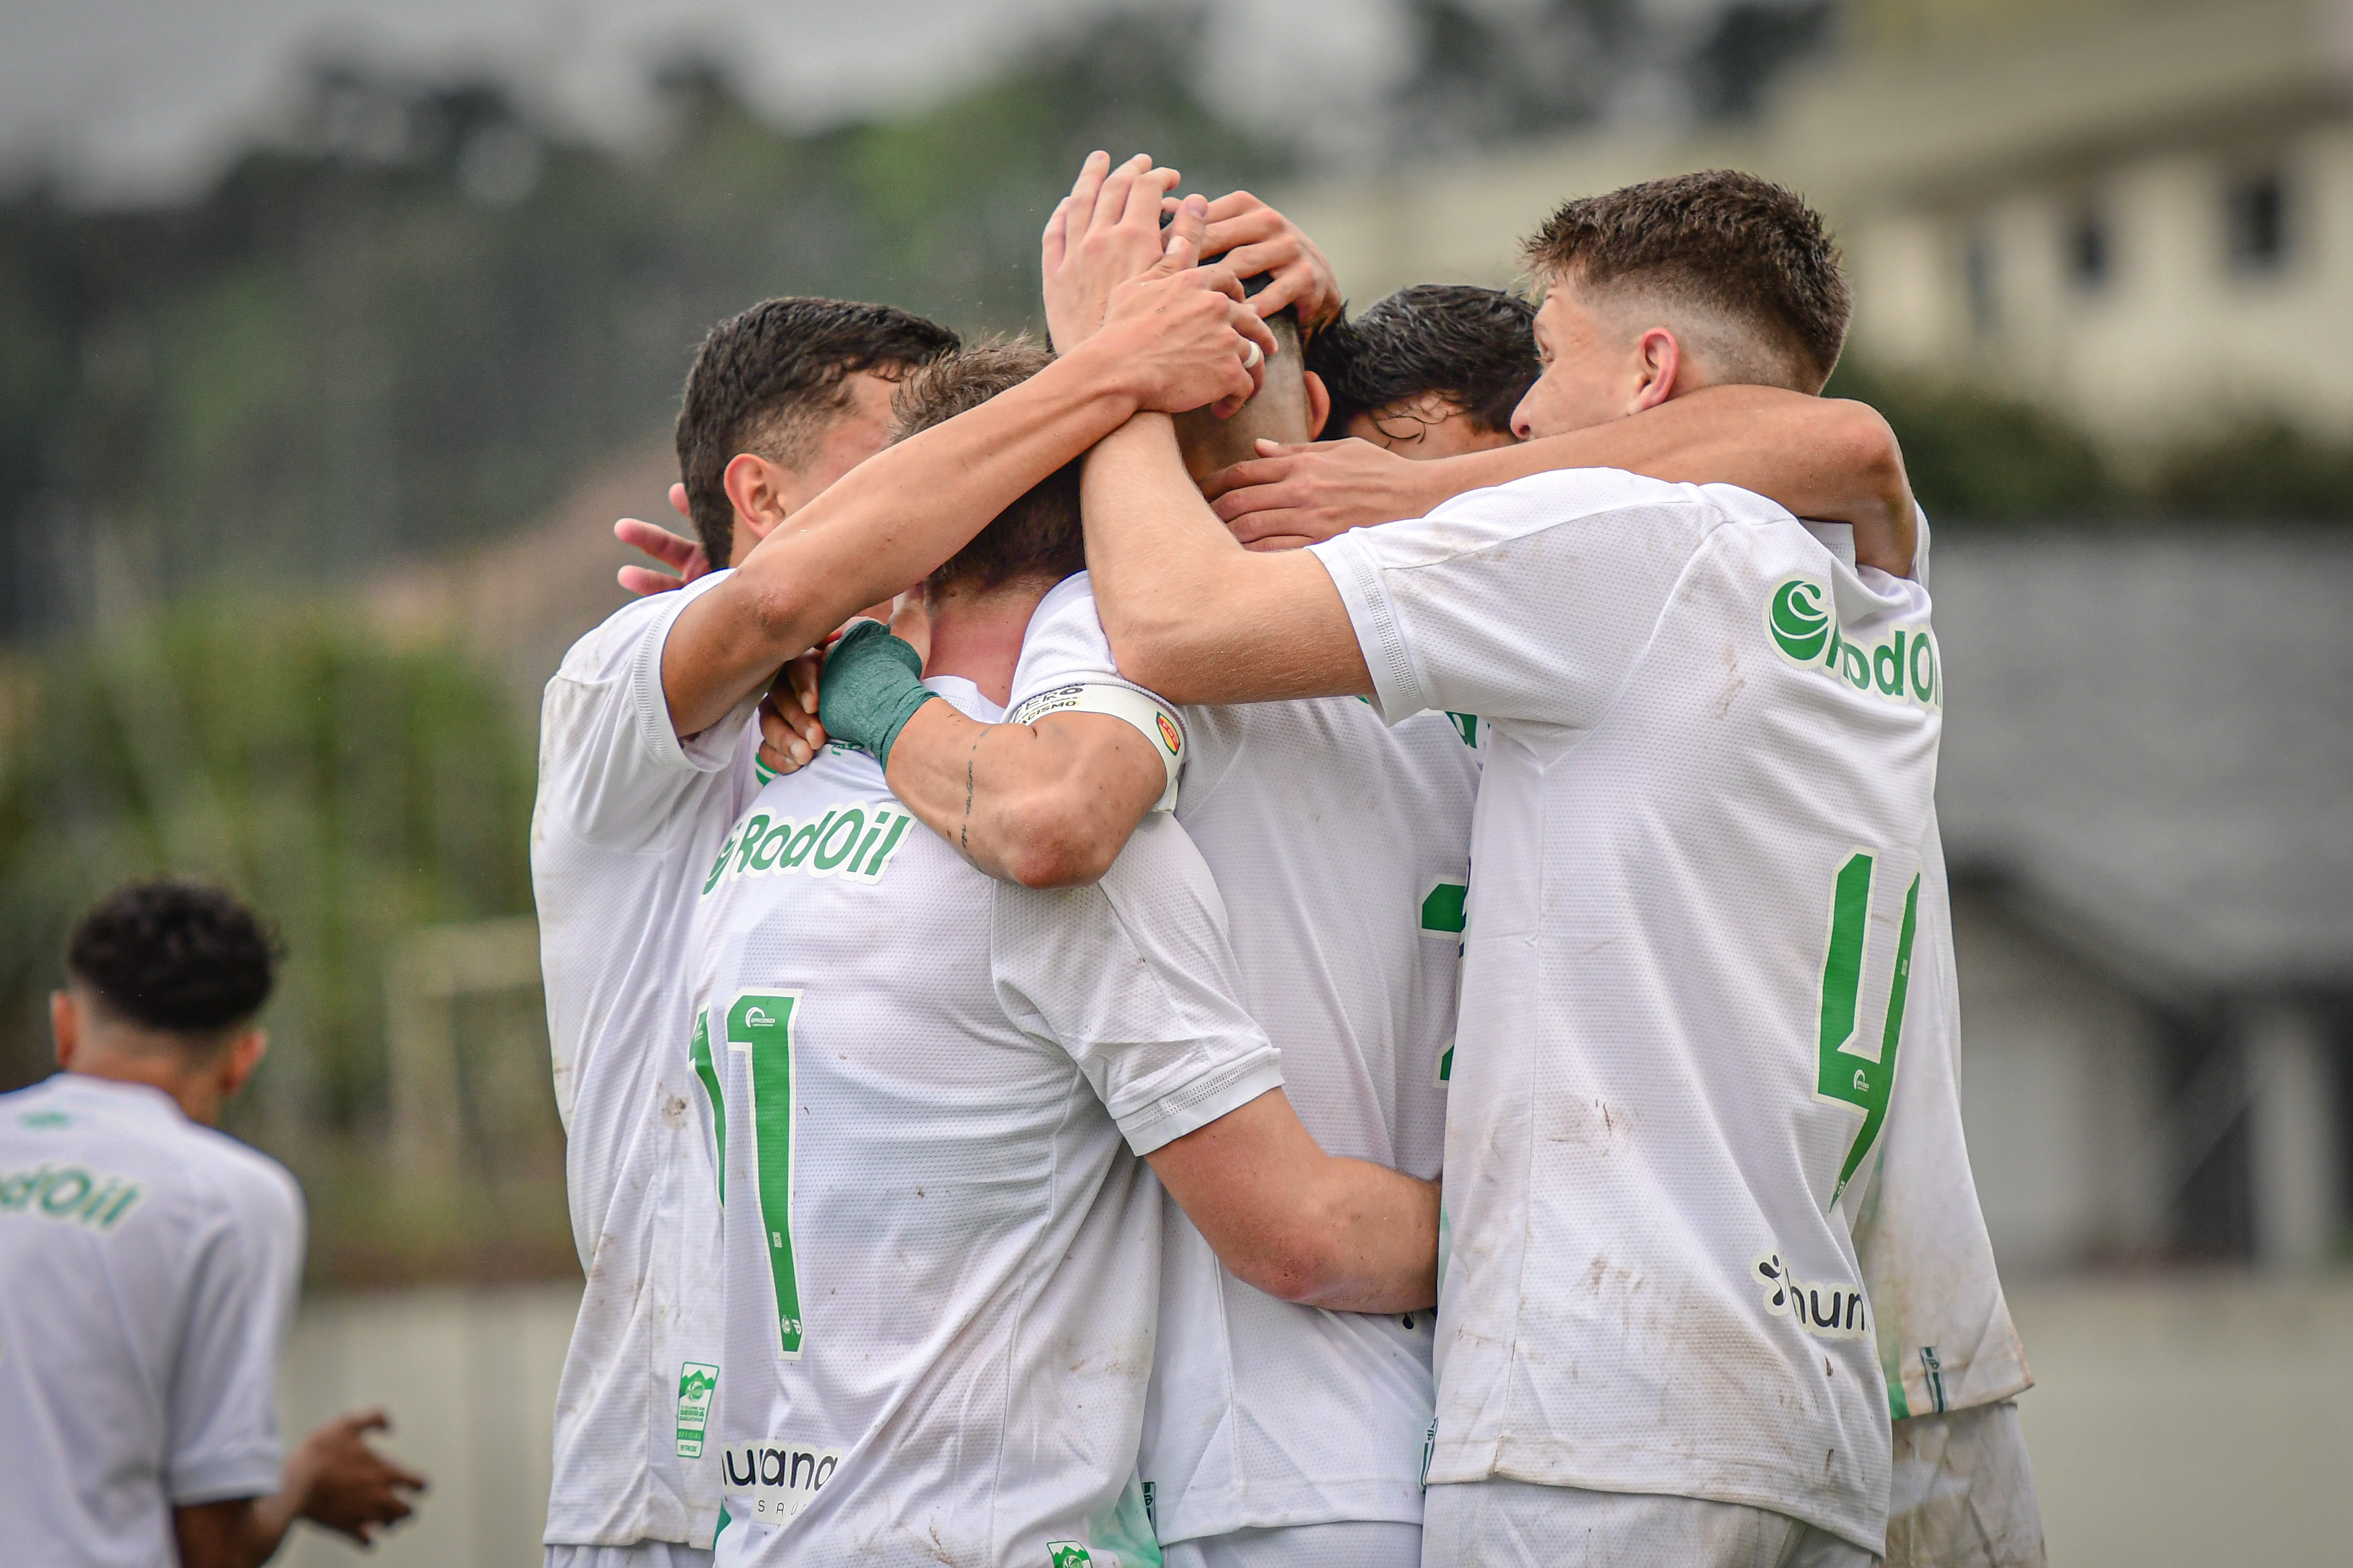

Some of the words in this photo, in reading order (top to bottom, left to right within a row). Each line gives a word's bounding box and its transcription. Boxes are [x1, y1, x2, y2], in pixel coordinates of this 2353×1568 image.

[737, 808, 911, 876] RodOil
[1818, 853, 1921, 1214] 4
[0, 1161, 141, 1225] dOil
